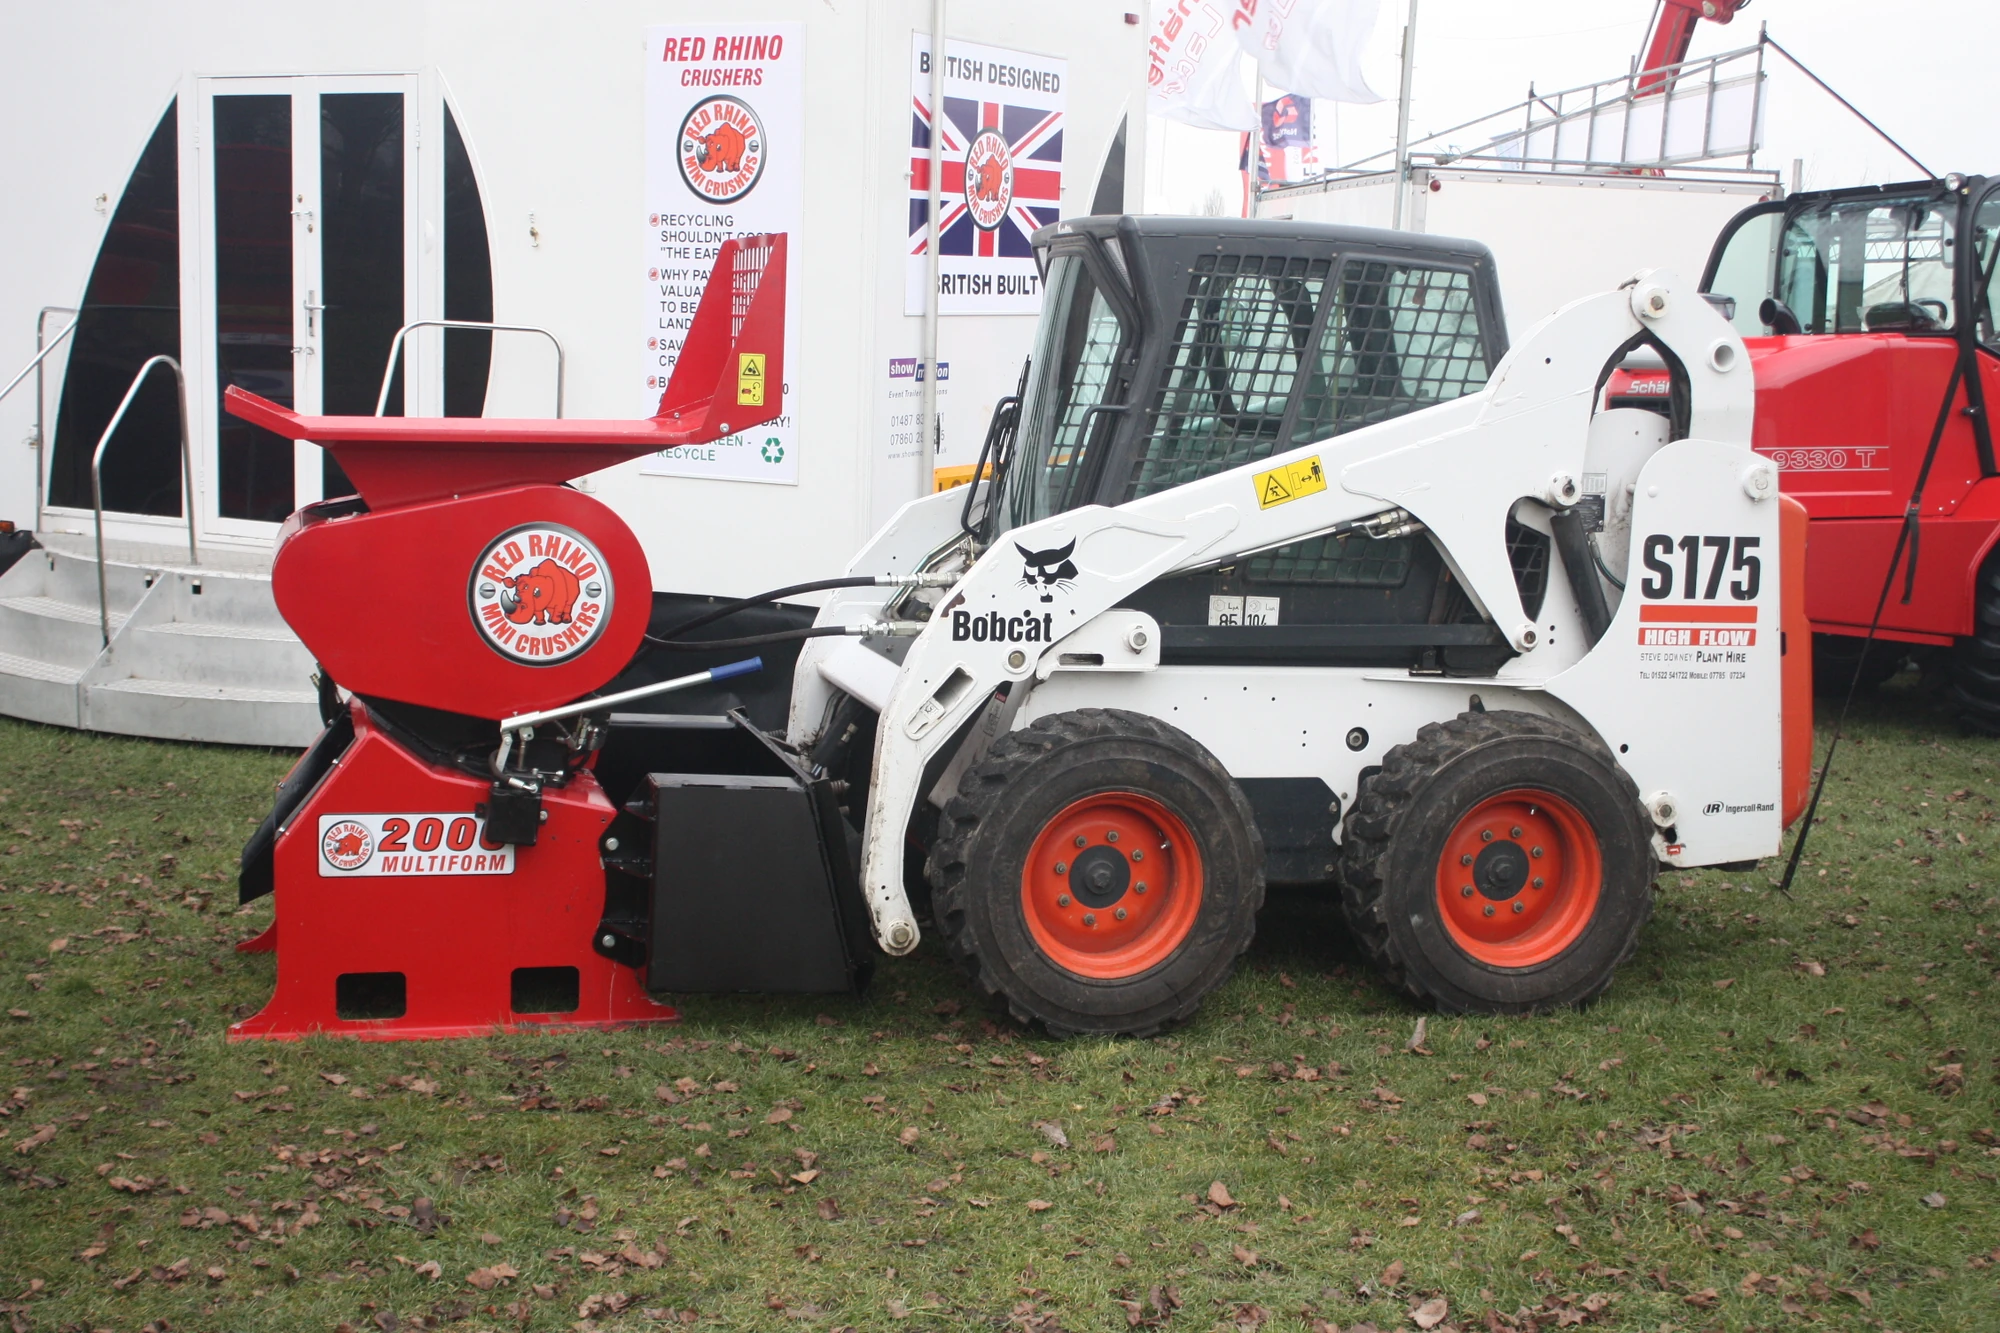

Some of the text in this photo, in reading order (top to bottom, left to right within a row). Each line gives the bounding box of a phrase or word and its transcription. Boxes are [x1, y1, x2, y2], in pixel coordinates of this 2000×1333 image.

[663, 35, 783, 62] RED RHINO
[681, 67, 763, 87] CRUSHERS
[919, 51, 1061, 94] BITISH DESIGNED
[685, 104, 757, 141] RED RHINO
[969, 135, 1009, 172] RED RHINO
[684, 154, 758, 197] MINI CRUSHERS
[968, 183, 1009, 225] MINI CRUSHERS
[660, 213, 734, 228] RECYCLING
[660, 230, 734, 243] SHOULDN'T
[694, 247, 720, 260] EAR
[660, 268, 689, 281] WHY
[660, 284, 706, 298] VALUA
[938, 273, 1039, 295] RITISH BUILT
[660, 300, 677, 313] TO
[659, 317, 693, 330] LAND
[659, 338, 684, 351] SAV
[890, 361, 915, 375] show
[888, 390, 904, 399] Event
[890, 414, 913, 428] 01487
[890, 432, 914, 446] 07860
[1771, 449, 1876, 469] 9330 T
[481, 534, 598, 584] RED RHINO
[1641, 534, 1761, 601] S175
[480, 601, 600, 656] MINI CRUSHERS
[952, 610, 1053, 642] Bobcat
[1644, 629, 1750, 646] HIGH FLOW
[1640, 652, 1661, 661] STEVE
[1705, 803, 1721, 814] IR
[326, 824, 369, 841] RED RHINO
[326, 847, 370, 867] MINI CRUSHERS
[381, 854, 507, 873] MULTIFORM
